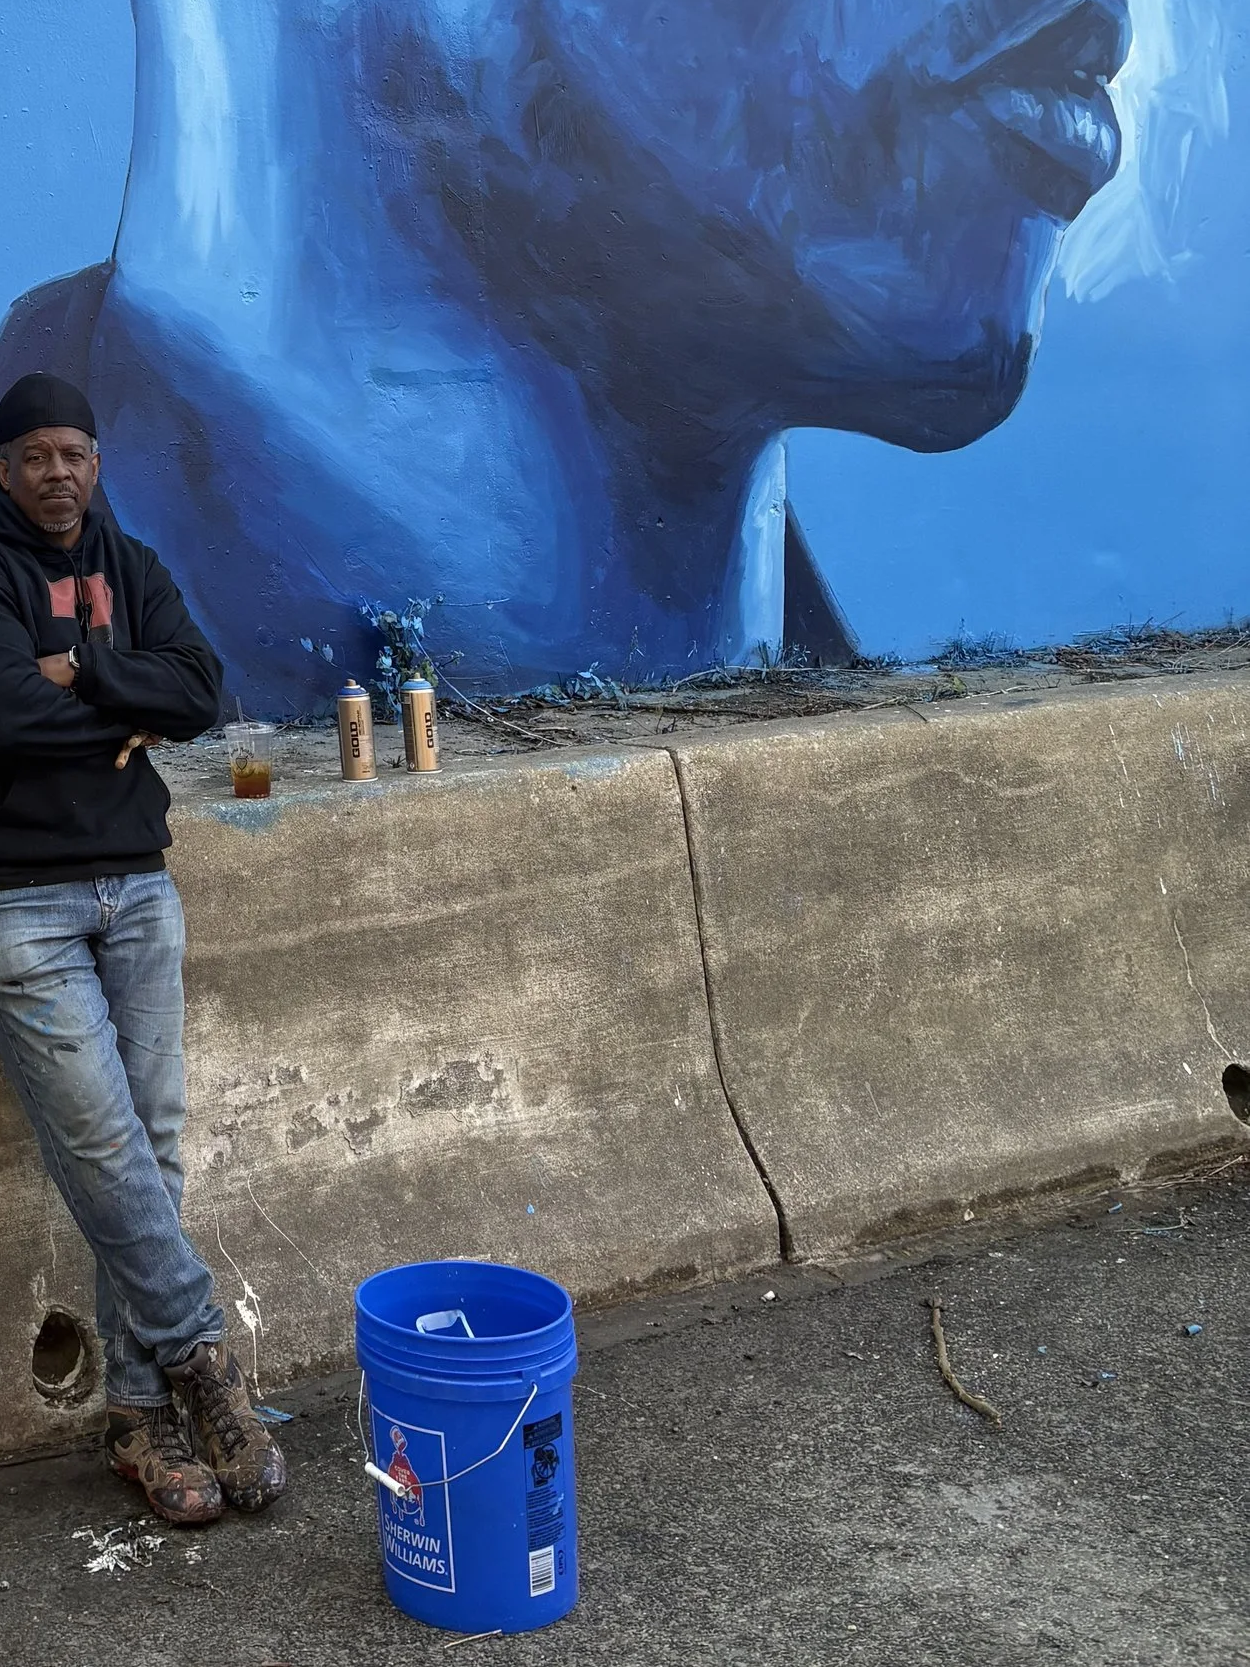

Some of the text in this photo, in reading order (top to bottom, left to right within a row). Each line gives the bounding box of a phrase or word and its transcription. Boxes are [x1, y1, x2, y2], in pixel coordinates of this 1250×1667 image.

[350, 721, 360, 758] GOLD
[425, 712, 434, 748] GOLD
[384, 1513, 440, 1554] SHERWIN
